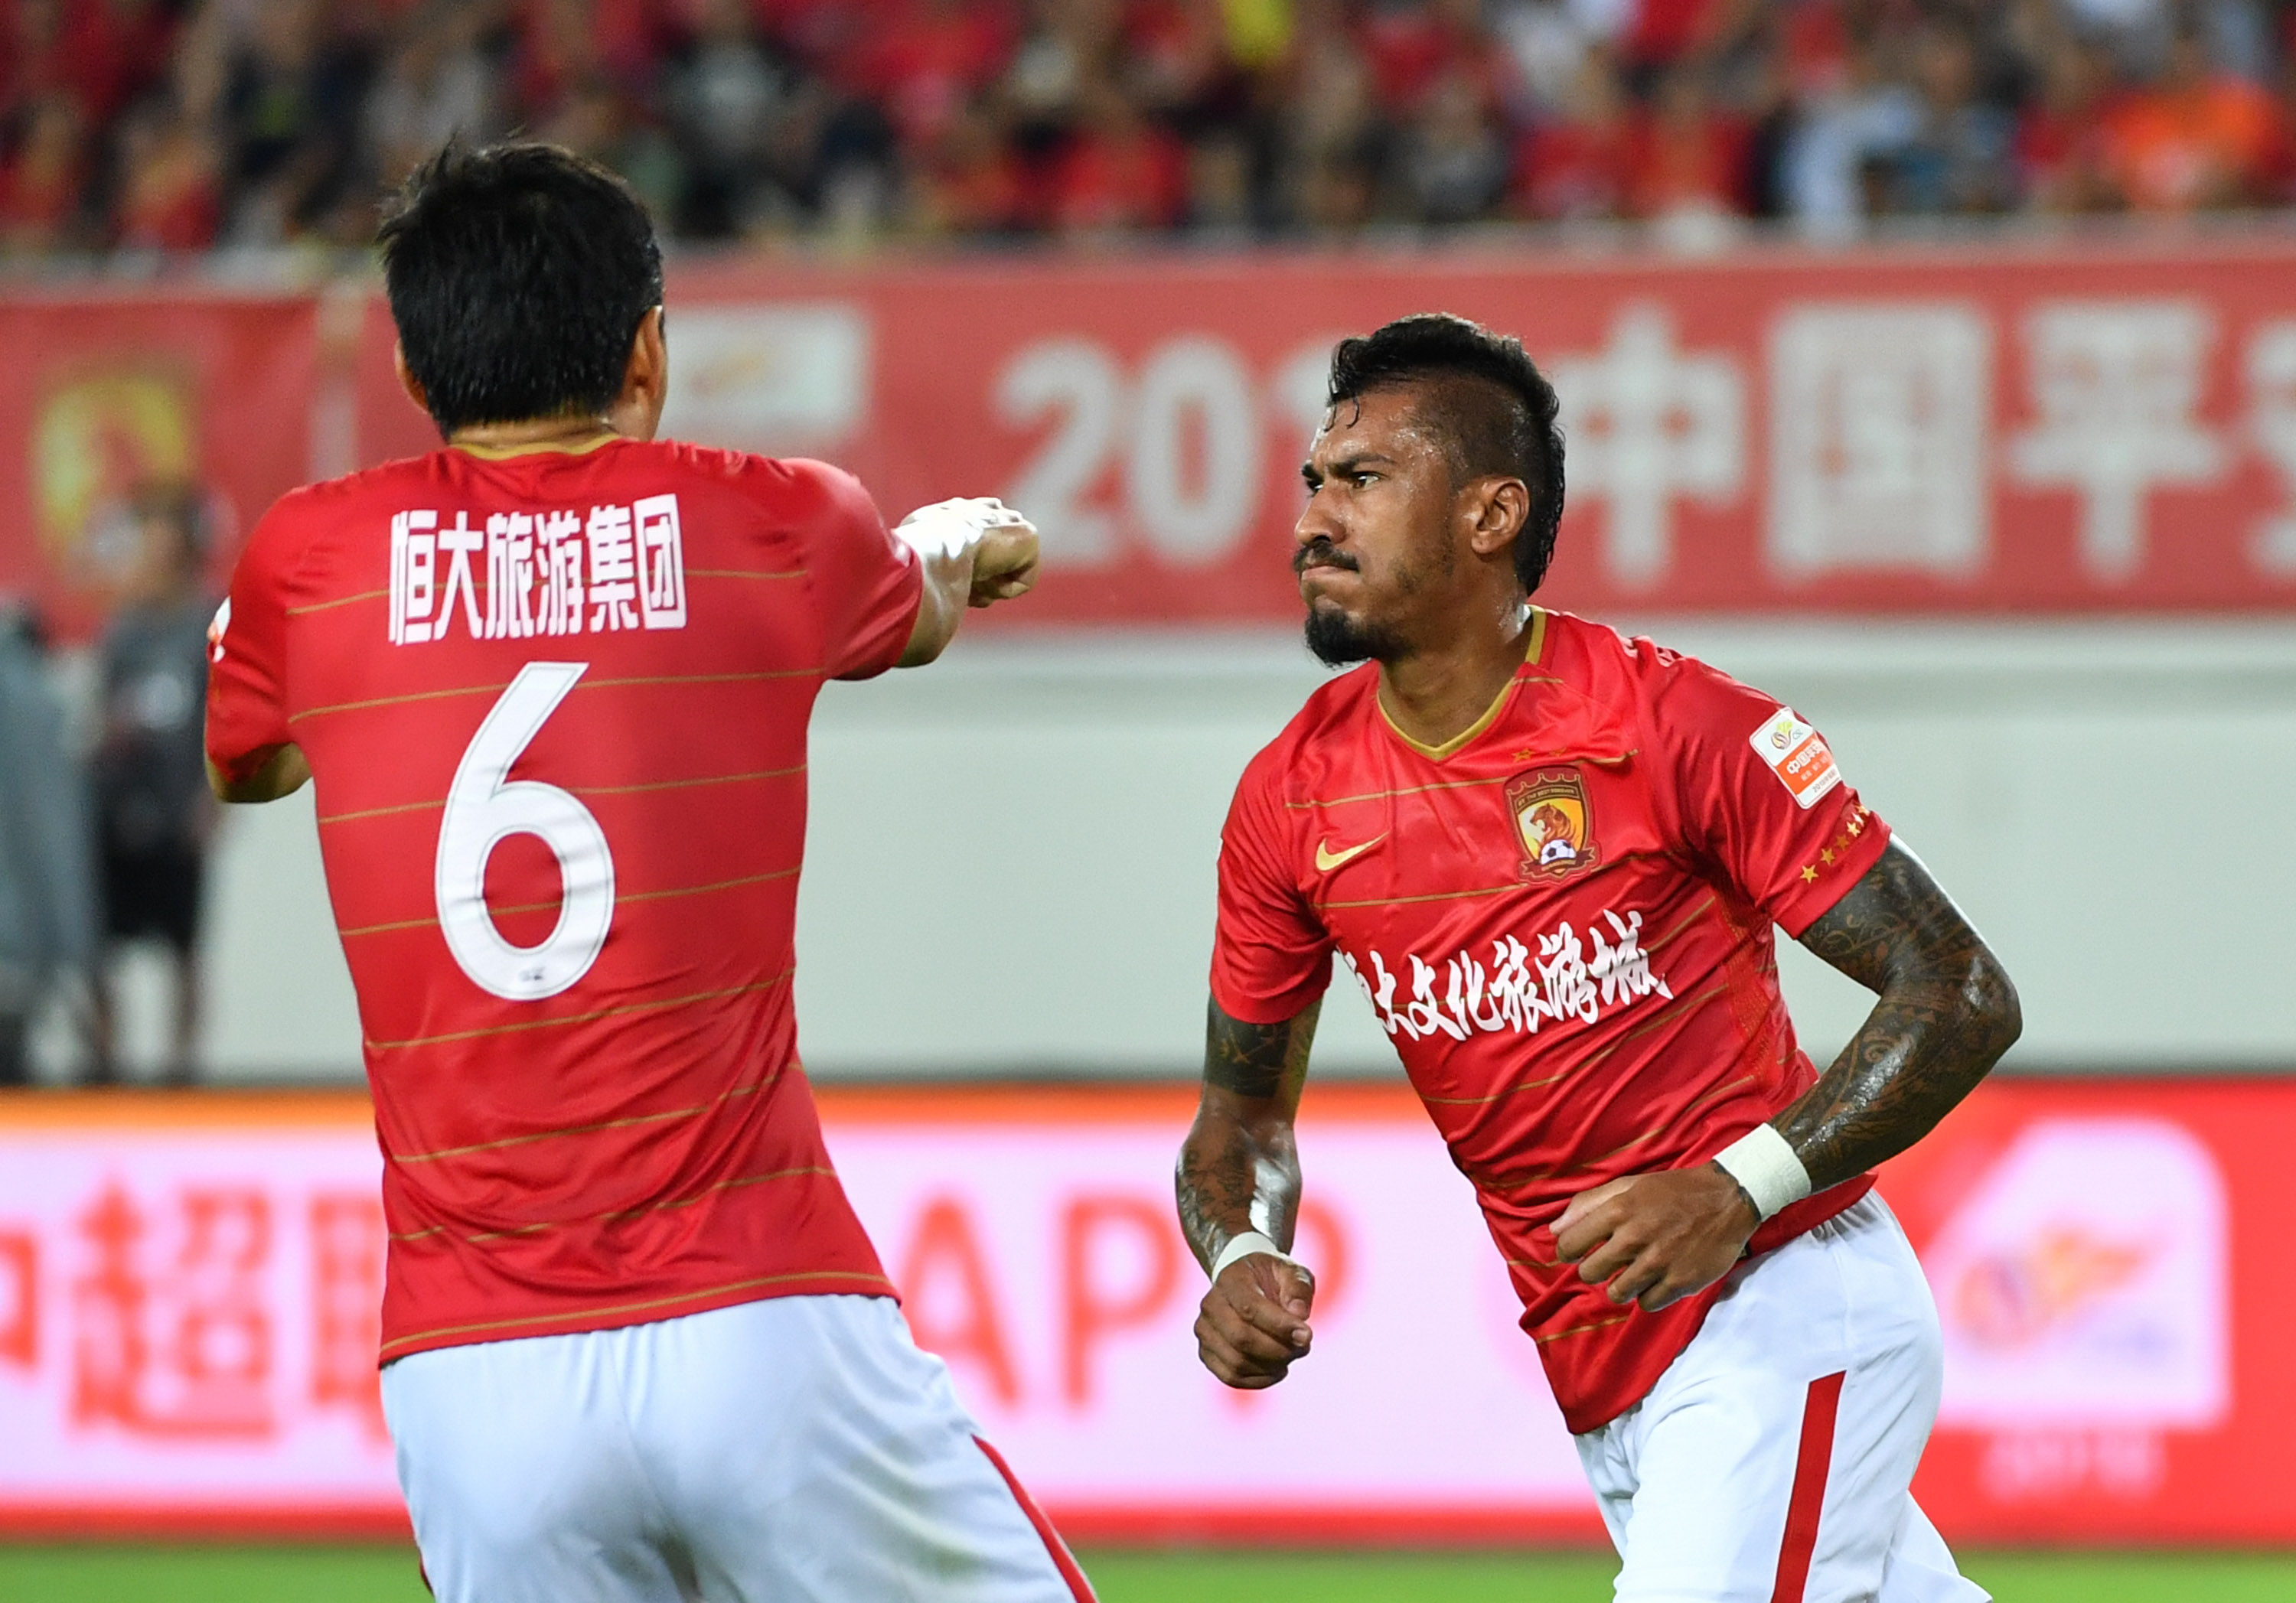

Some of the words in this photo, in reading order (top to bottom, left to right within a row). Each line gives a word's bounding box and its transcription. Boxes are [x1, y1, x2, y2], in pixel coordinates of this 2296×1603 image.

[388, 494, 687, 646] 恒大旅游集团
[435, 661, 615, 1001] 6
[1336, 909, 1674, 1042] 大文化旅游城
